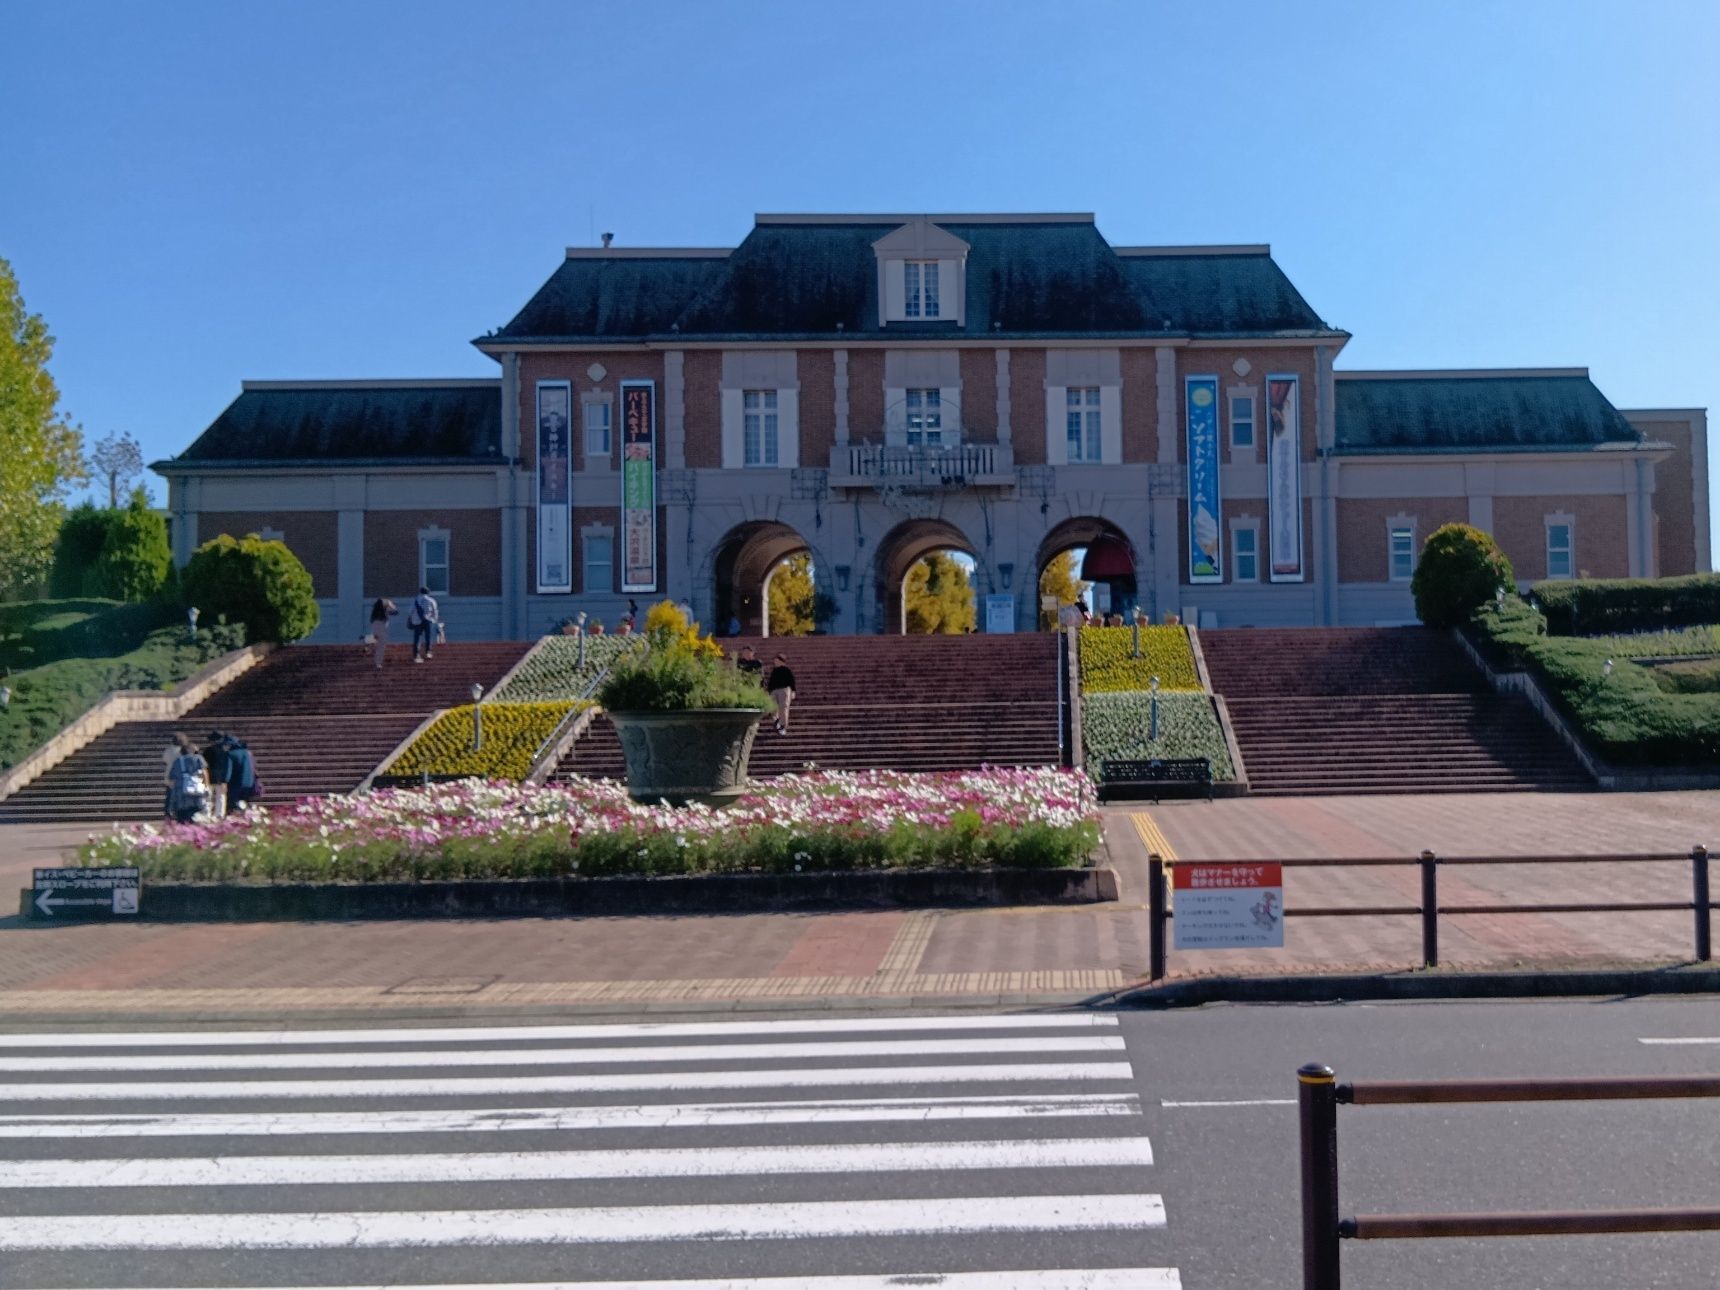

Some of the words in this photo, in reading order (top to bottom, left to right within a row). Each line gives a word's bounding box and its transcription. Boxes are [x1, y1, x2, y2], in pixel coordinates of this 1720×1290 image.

[1191, 422, 1207, 503] ソフトクリーム
[1190, 866, 1264, 878] 犬はマナーを守って
